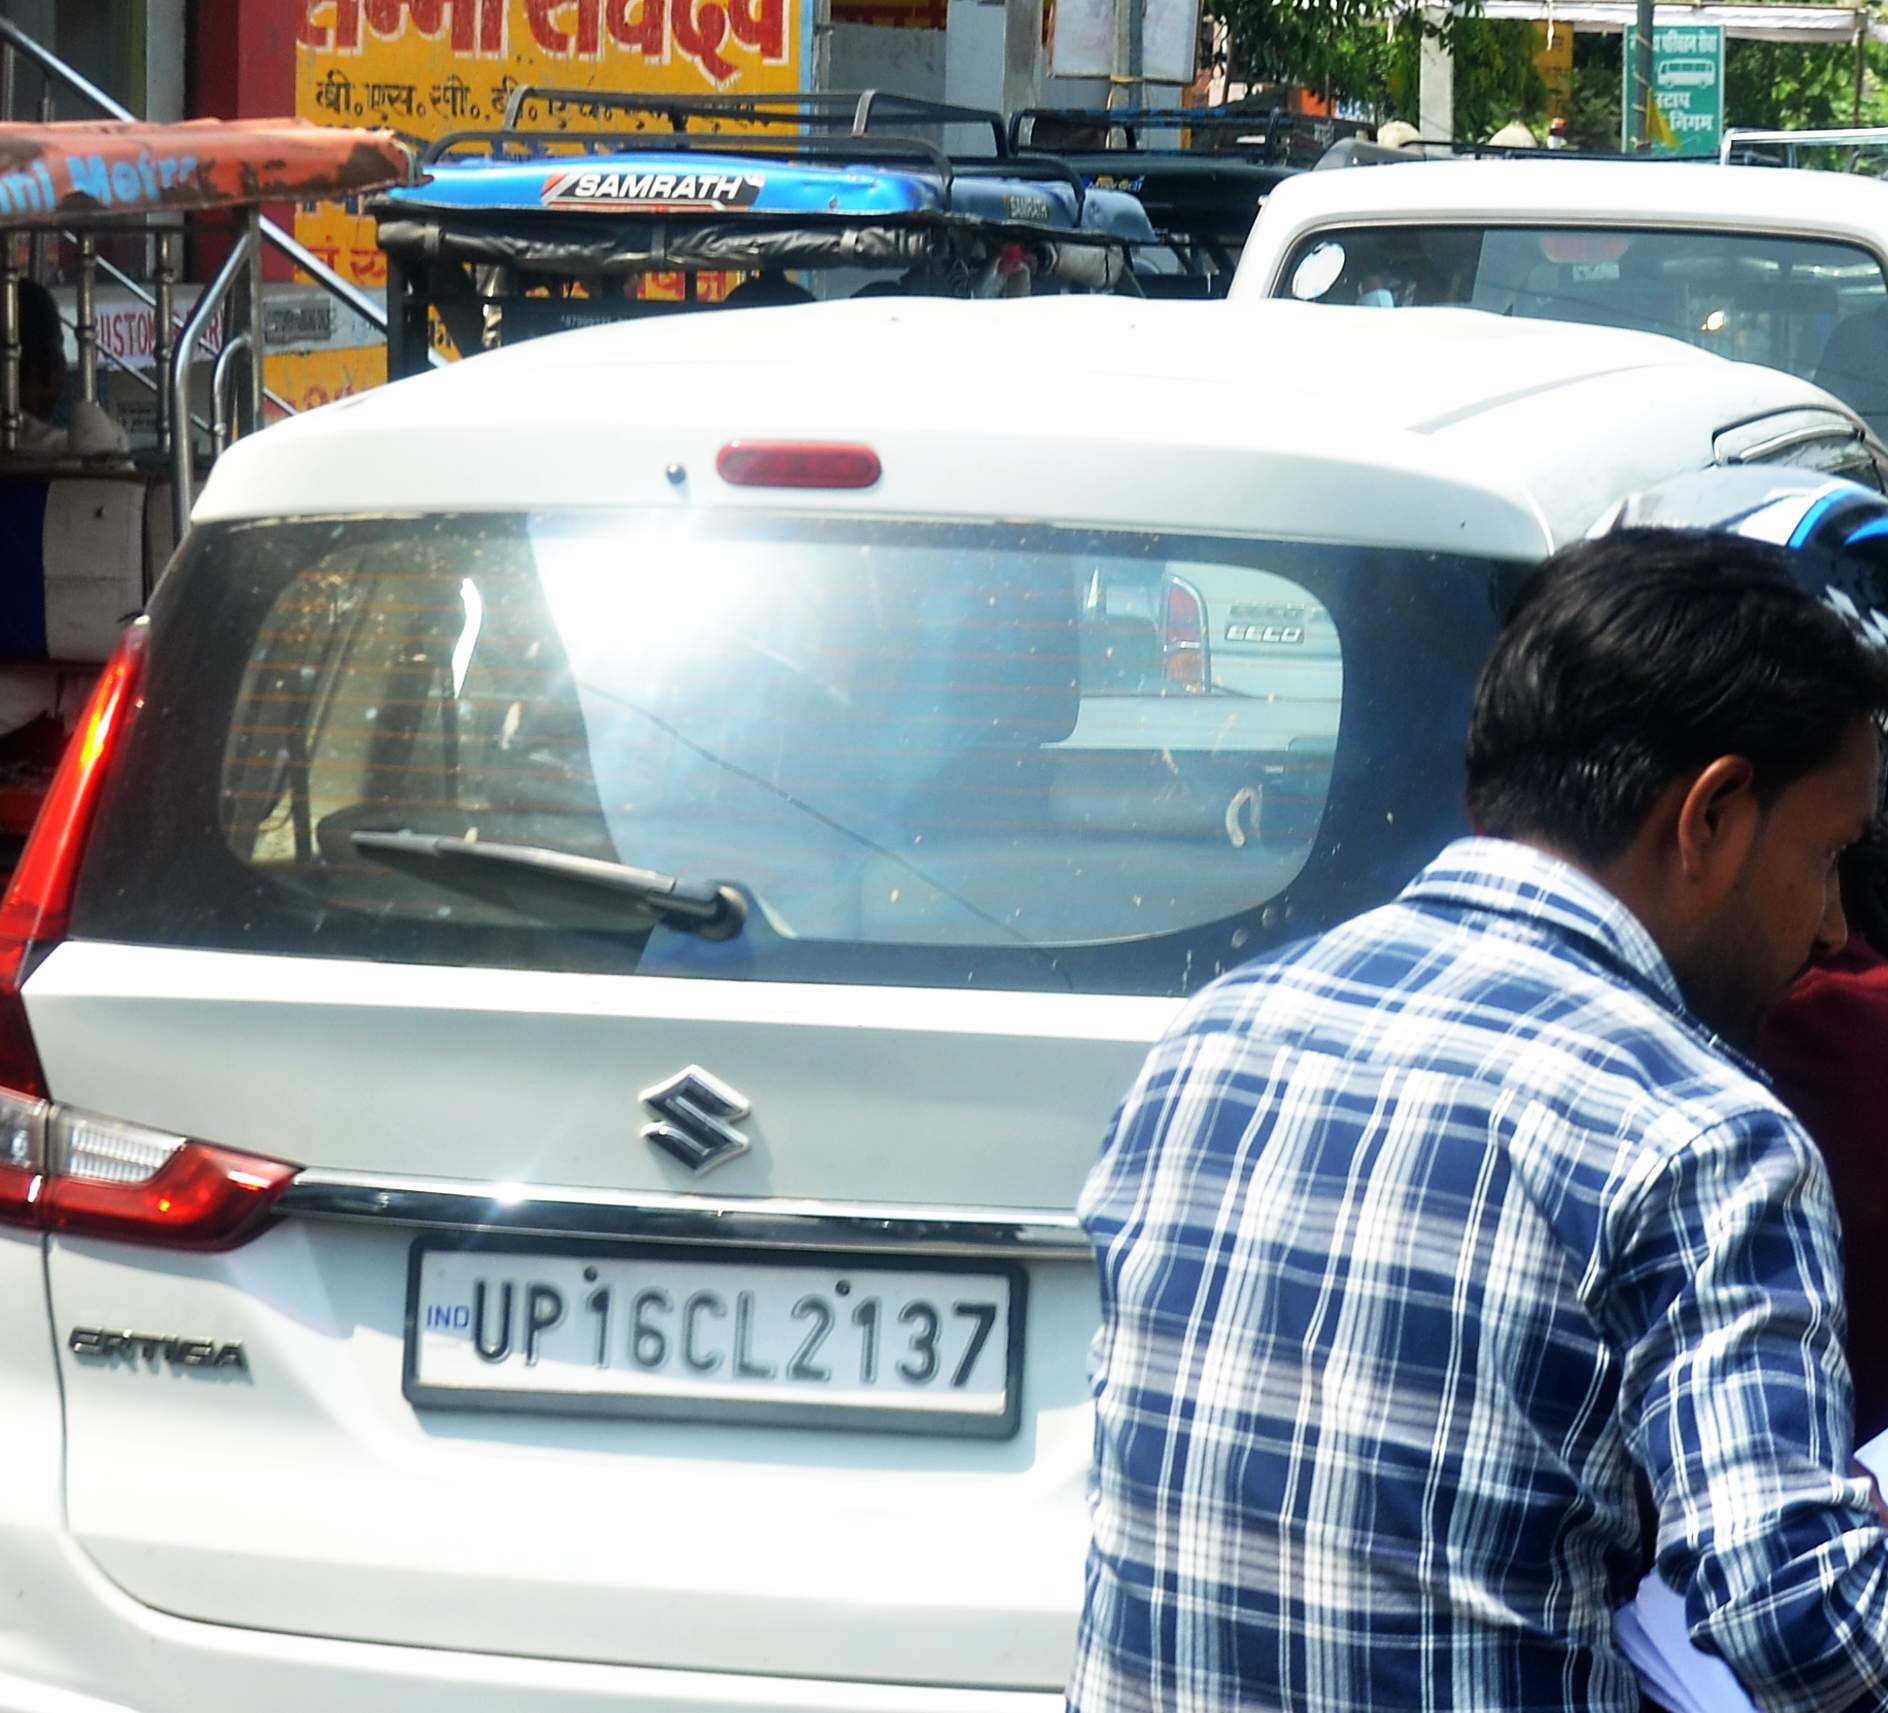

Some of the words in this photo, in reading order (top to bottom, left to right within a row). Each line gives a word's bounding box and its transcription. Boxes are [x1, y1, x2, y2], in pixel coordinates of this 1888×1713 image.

[574, 174, 743, 199] SAMRATH
[68, 1325, 249, 1374] ERTIGA
[426, 1304, 470, 1332] IND
[473, 1277, 998, 1388] UP16CL2137
